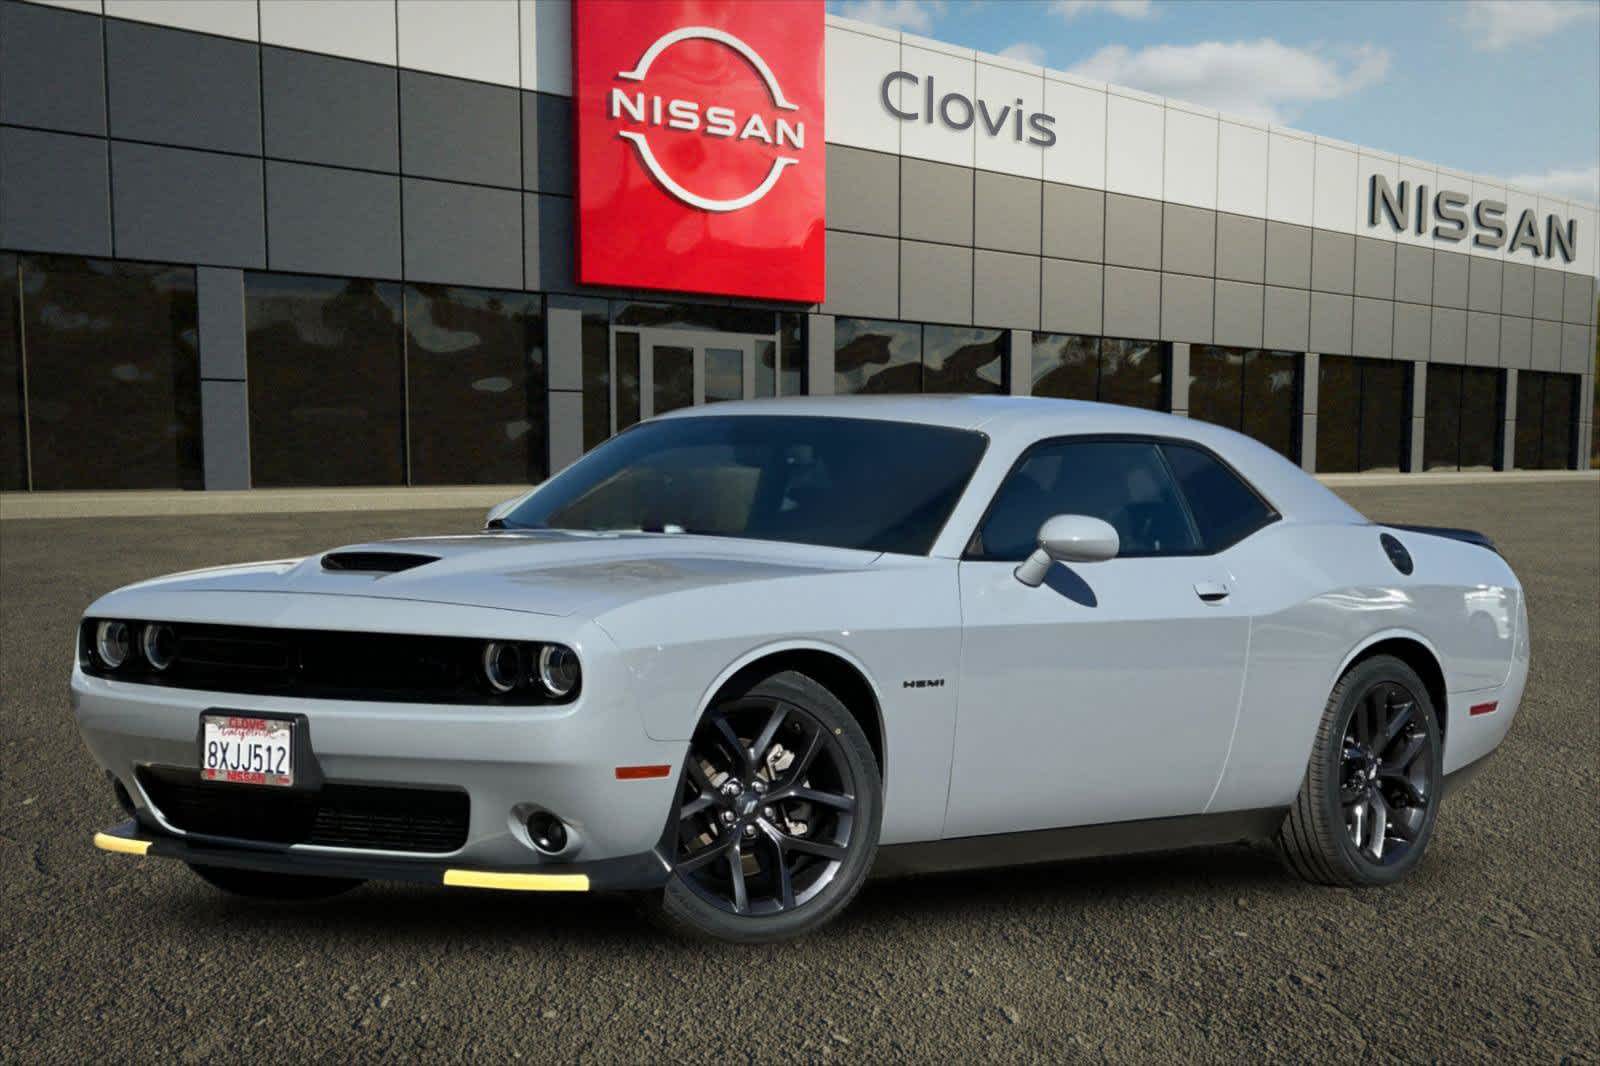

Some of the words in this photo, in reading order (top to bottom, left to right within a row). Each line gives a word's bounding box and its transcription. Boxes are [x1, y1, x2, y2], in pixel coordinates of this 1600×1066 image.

[611, 87, 804, 148] NISSAN
[881, 70, 1057, 147] Clovis
[1368, 173, 1577, 263] NISSAN
[229, 718, 266, 729] CLOVIS
[208, 741, 286, 774] 8XJJ512
[227, 771, 266, 784] NISSAN
